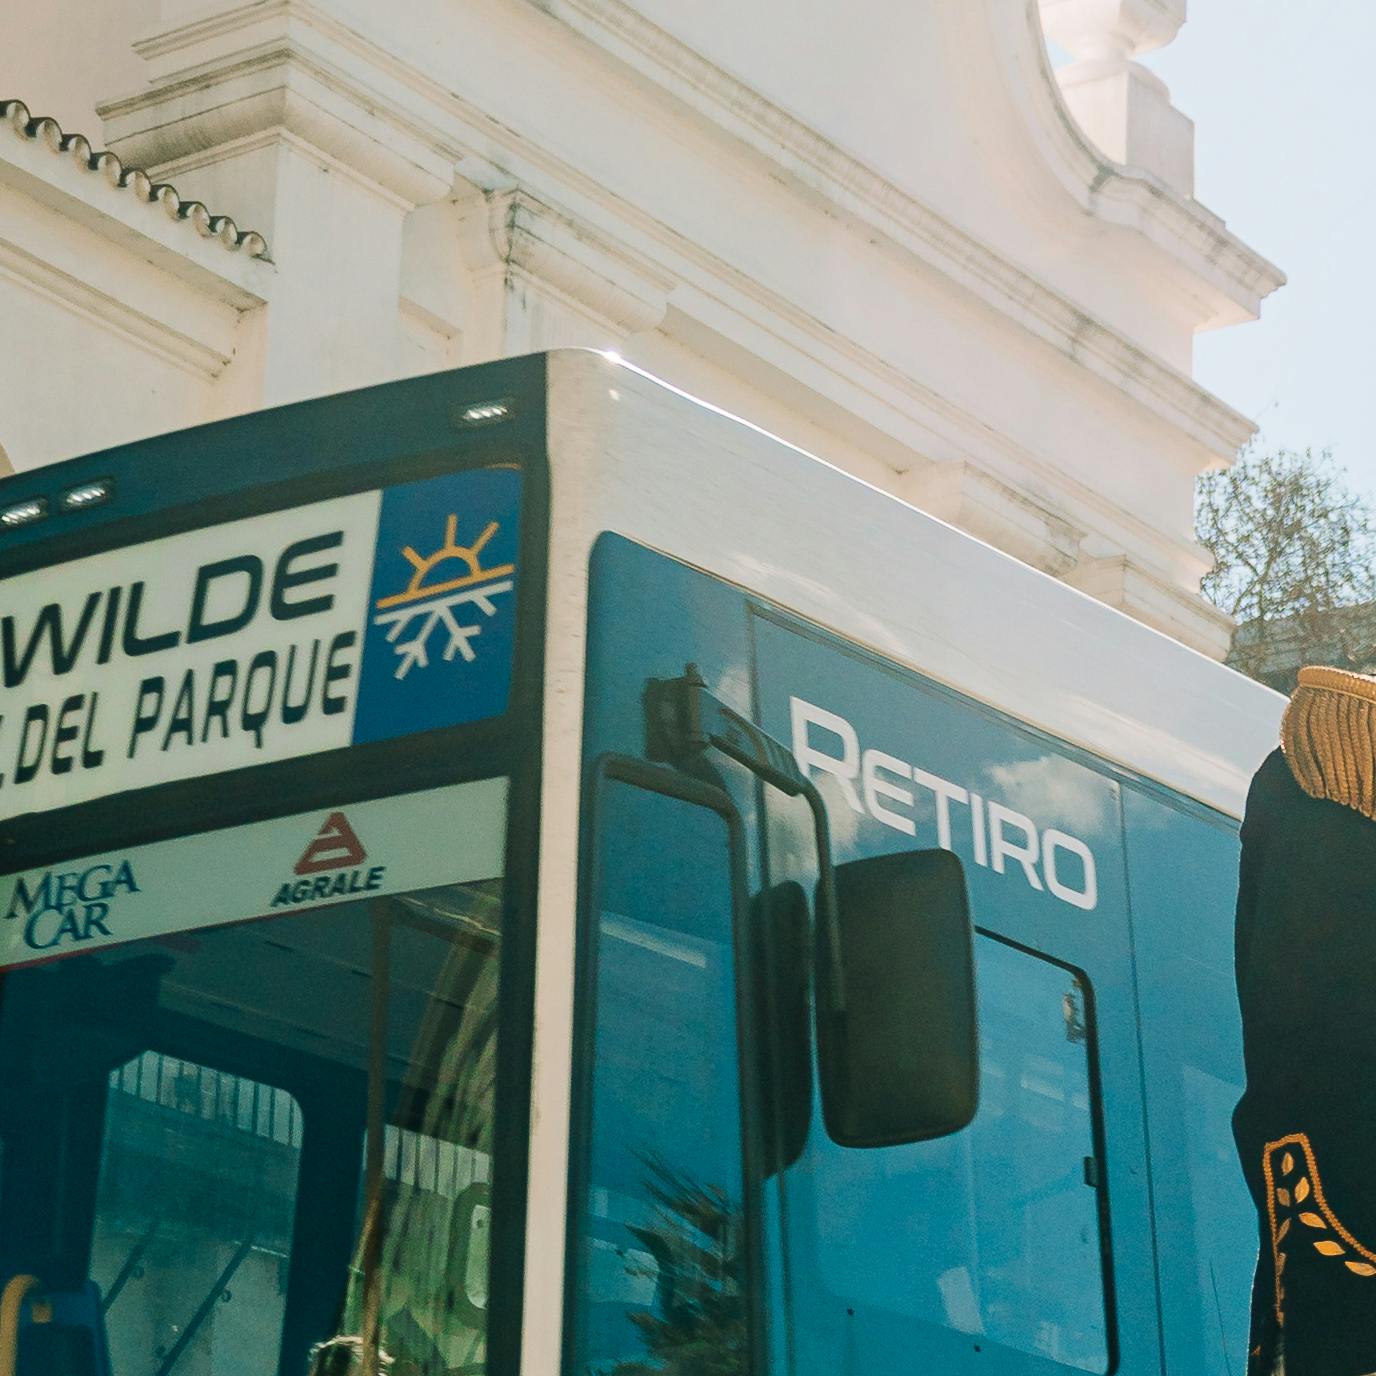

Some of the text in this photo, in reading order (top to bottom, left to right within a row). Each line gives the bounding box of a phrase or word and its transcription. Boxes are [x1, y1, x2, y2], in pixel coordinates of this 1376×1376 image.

[0, 530, 345, 689] WILDE
[127, 630, 357, 760] PARQUE
[789, 695, 1098, 912] RETIRO
[3, 859, 141, 920] MEGA
[24, 902, 113, 950] CAR
[270, 866, 387, 908] AGRALE
